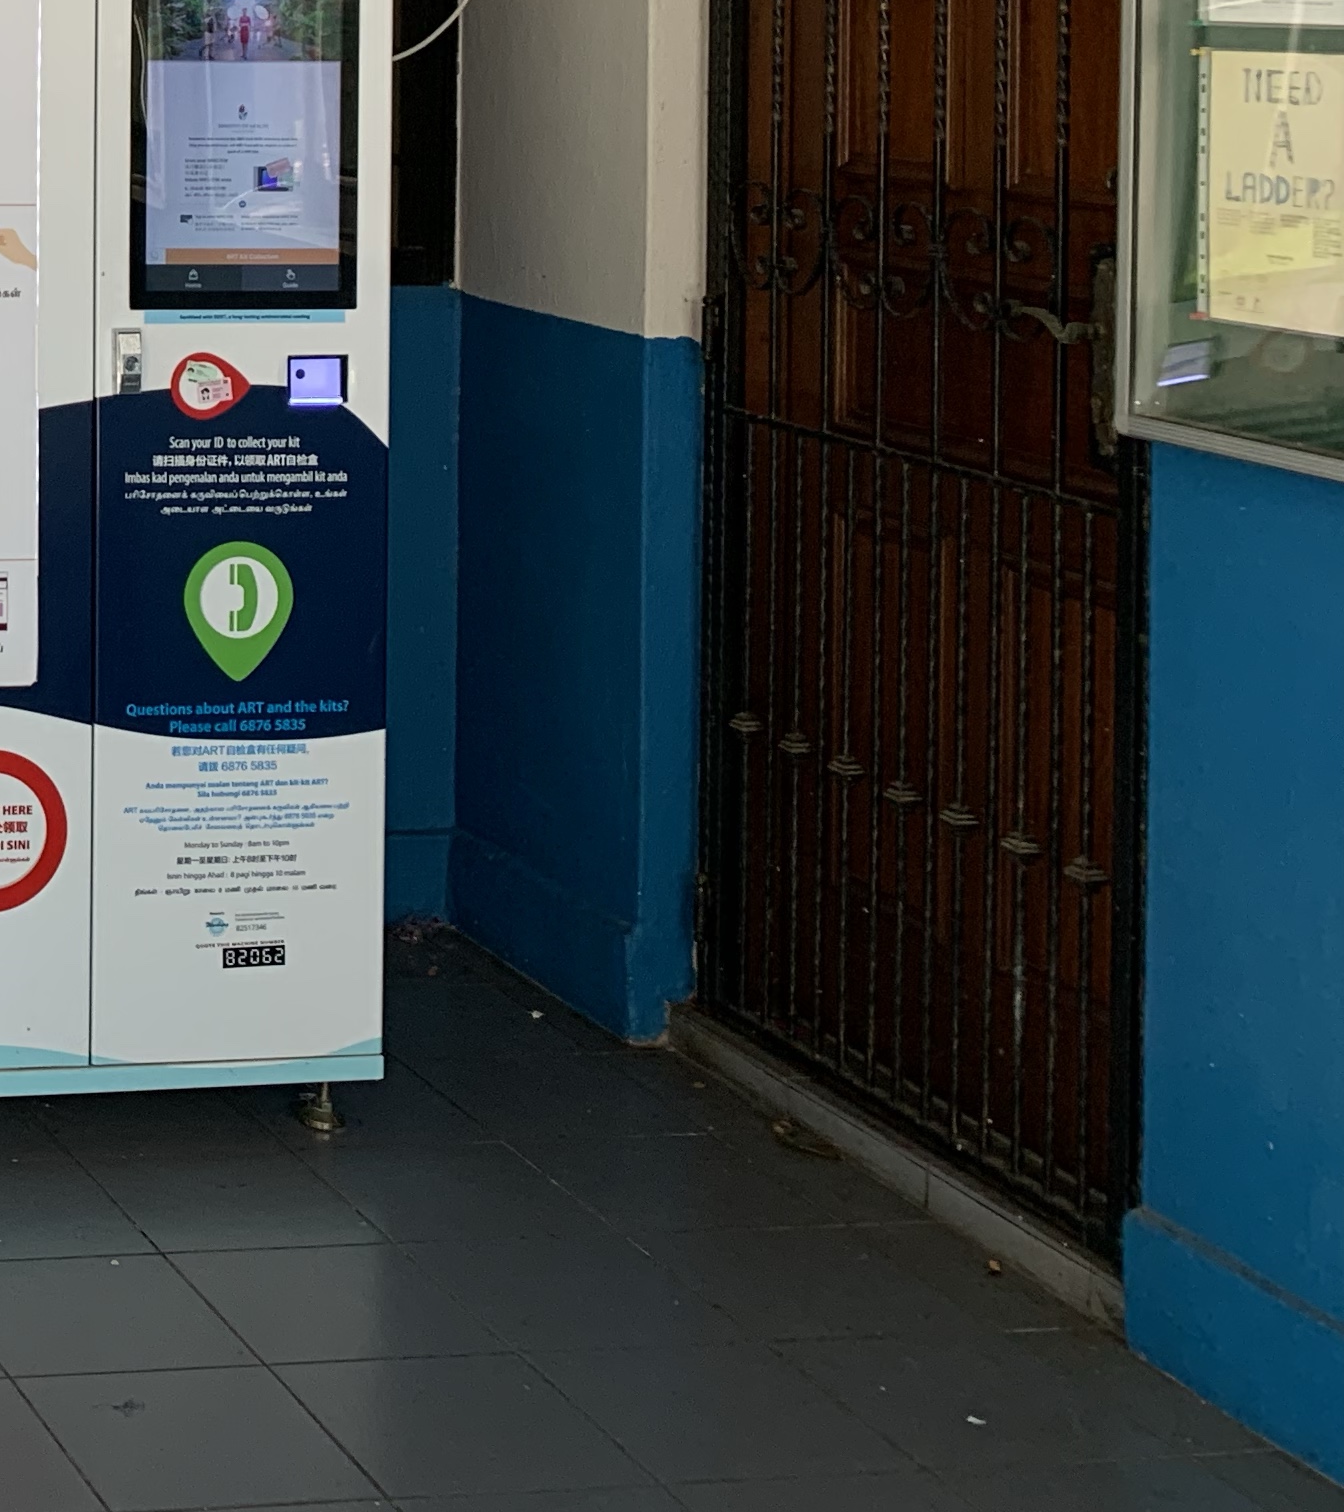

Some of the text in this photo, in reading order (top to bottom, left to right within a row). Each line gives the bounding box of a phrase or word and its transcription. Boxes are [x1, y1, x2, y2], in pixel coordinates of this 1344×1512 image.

[1242, 68, 1323, 106] NEED
[1270, 110, 1294, 168] A
[1226, 172, 1336, 210] LADDER?
[225, 949, 284, 966] 82062
